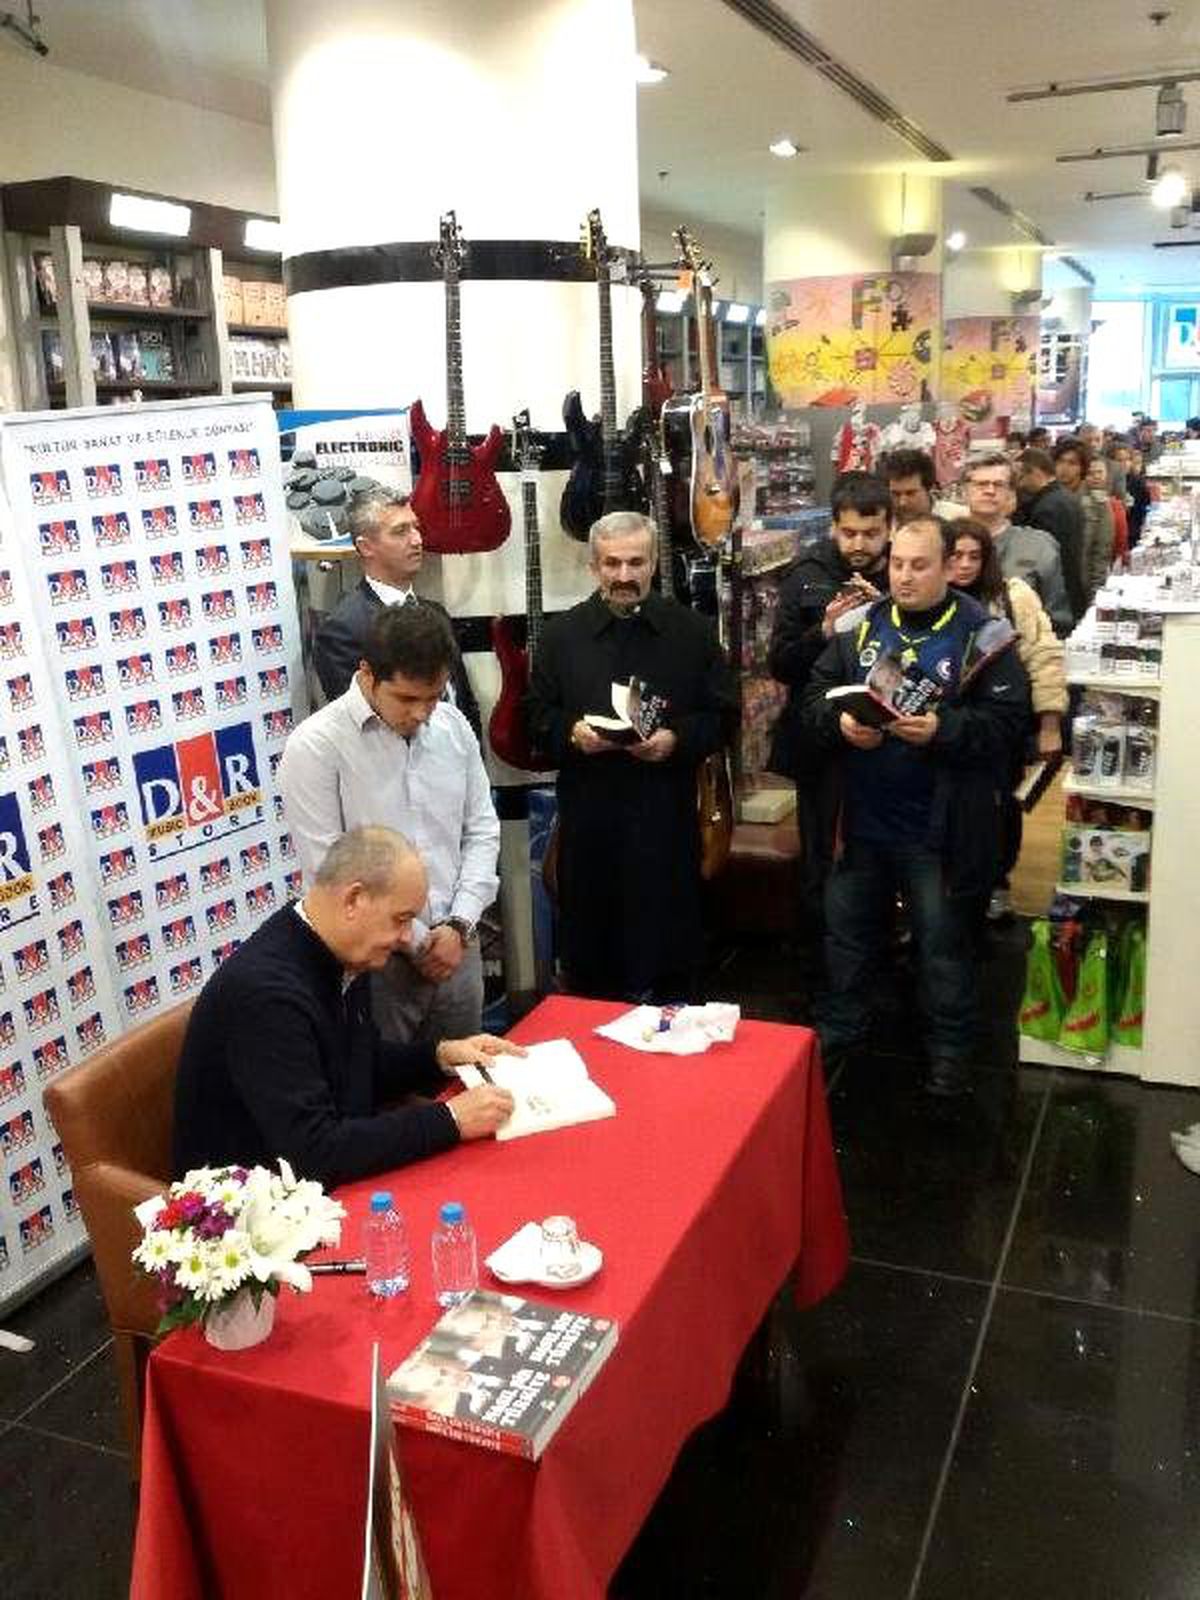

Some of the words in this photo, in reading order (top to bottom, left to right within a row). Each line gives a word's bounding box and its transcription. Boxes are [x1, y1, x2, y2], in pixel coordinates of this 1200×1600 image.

[141, 753, 255, 821] D&R
[148, 806, 263, 857] STORE
[500, 1371, 550, 1427] TÜRKİYE
